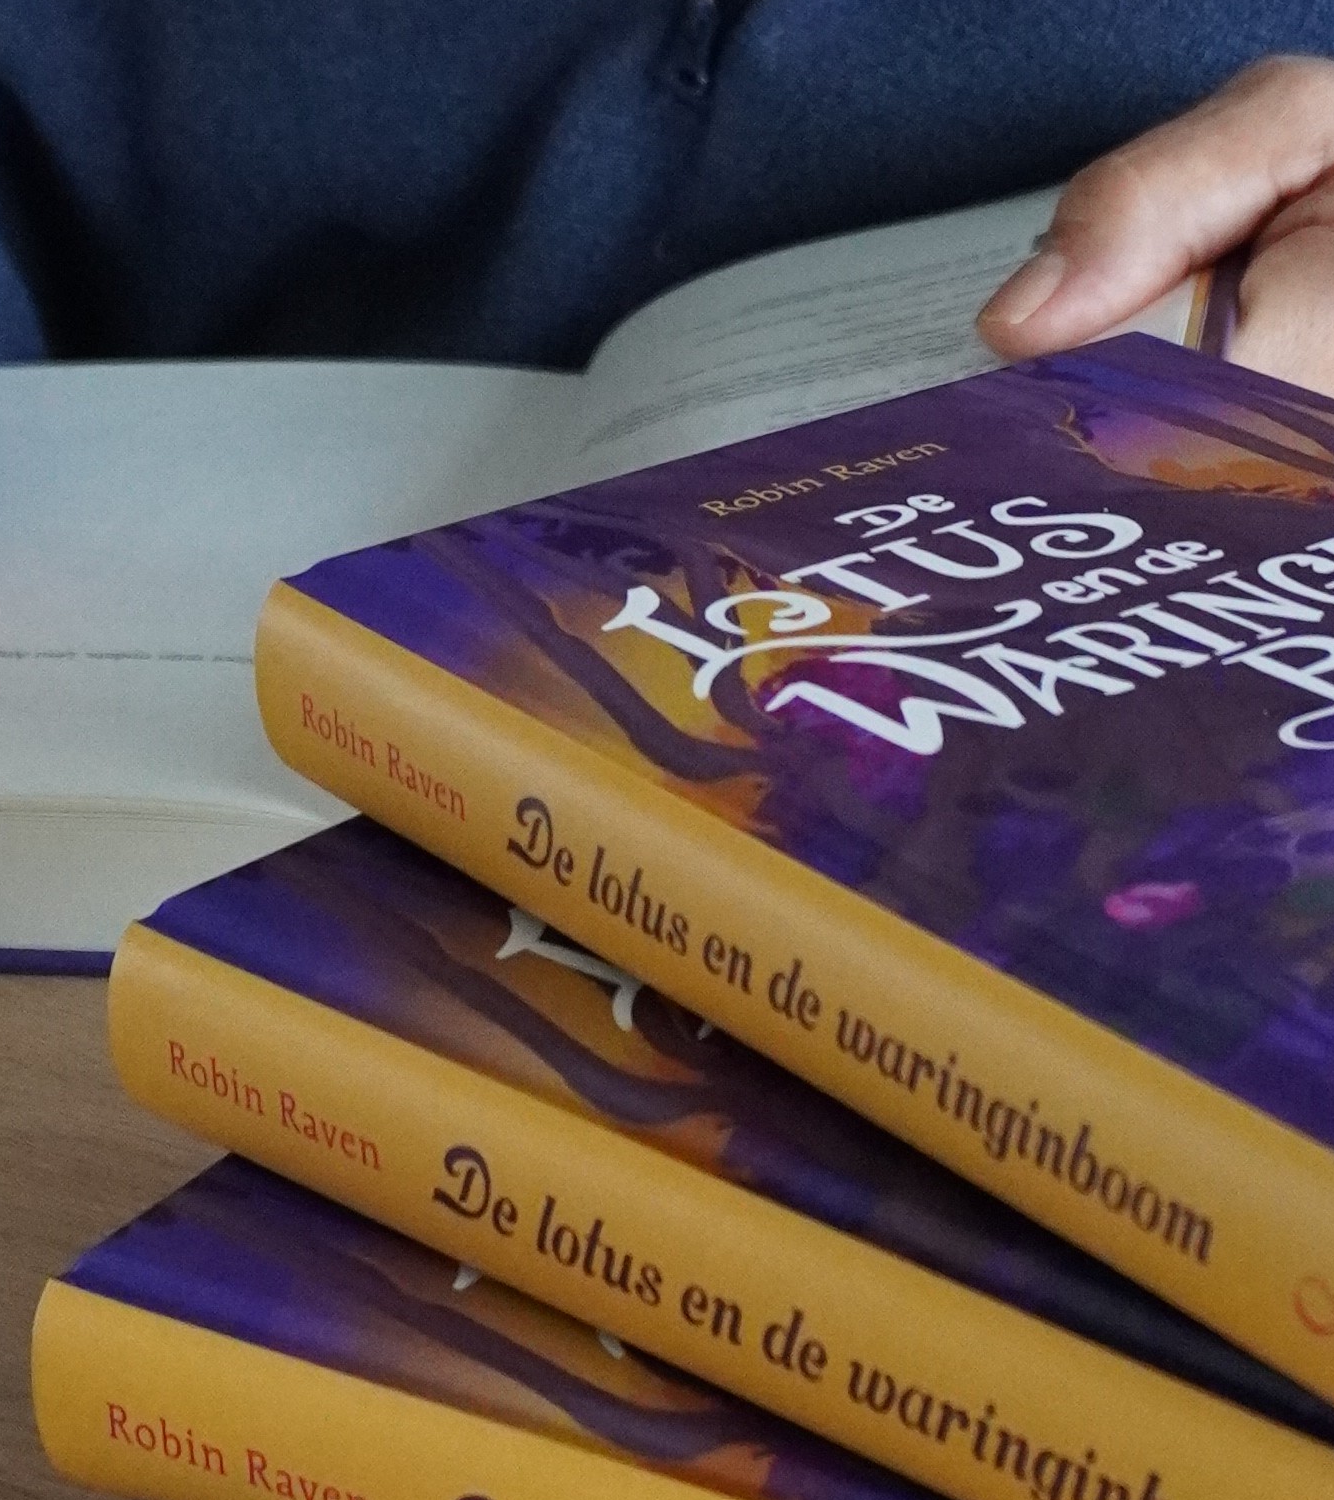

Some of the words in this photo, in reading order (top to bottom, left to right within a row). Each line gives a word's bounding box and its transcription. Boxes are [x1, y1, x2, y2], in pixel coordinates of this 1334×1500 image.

[700, 477, 824, 517] Robin
[821, 440, 949, 482] Raven
[834, 493, 955, 538] De
[601, 496, 1144, 699] LOTUS
[1041, 567, 1148, 604] en
[1135, 539, 1224, 574] de
[300, 694, 376, 769] Robin
[386, 742, 467, 822] Raven
[507, 797, 575, 886] De
[589, 846, 688, 957] lotus
[703, 934, 753, 995] en
[768, 960, 821, 1030] de
[836, 1003, 1217, 1266] waringinboom
[167, 1039, 265, 1118] Robin
[278, 1089, 383, 1171] Raven
[432, 1145, 519, 1238] De
[536, 1197, 663, 1307] lotus
[679, 1281, 745, 1348] en
[761, 1309, 828, 1383] de
[106, 1402, 227, 1477] Robin
